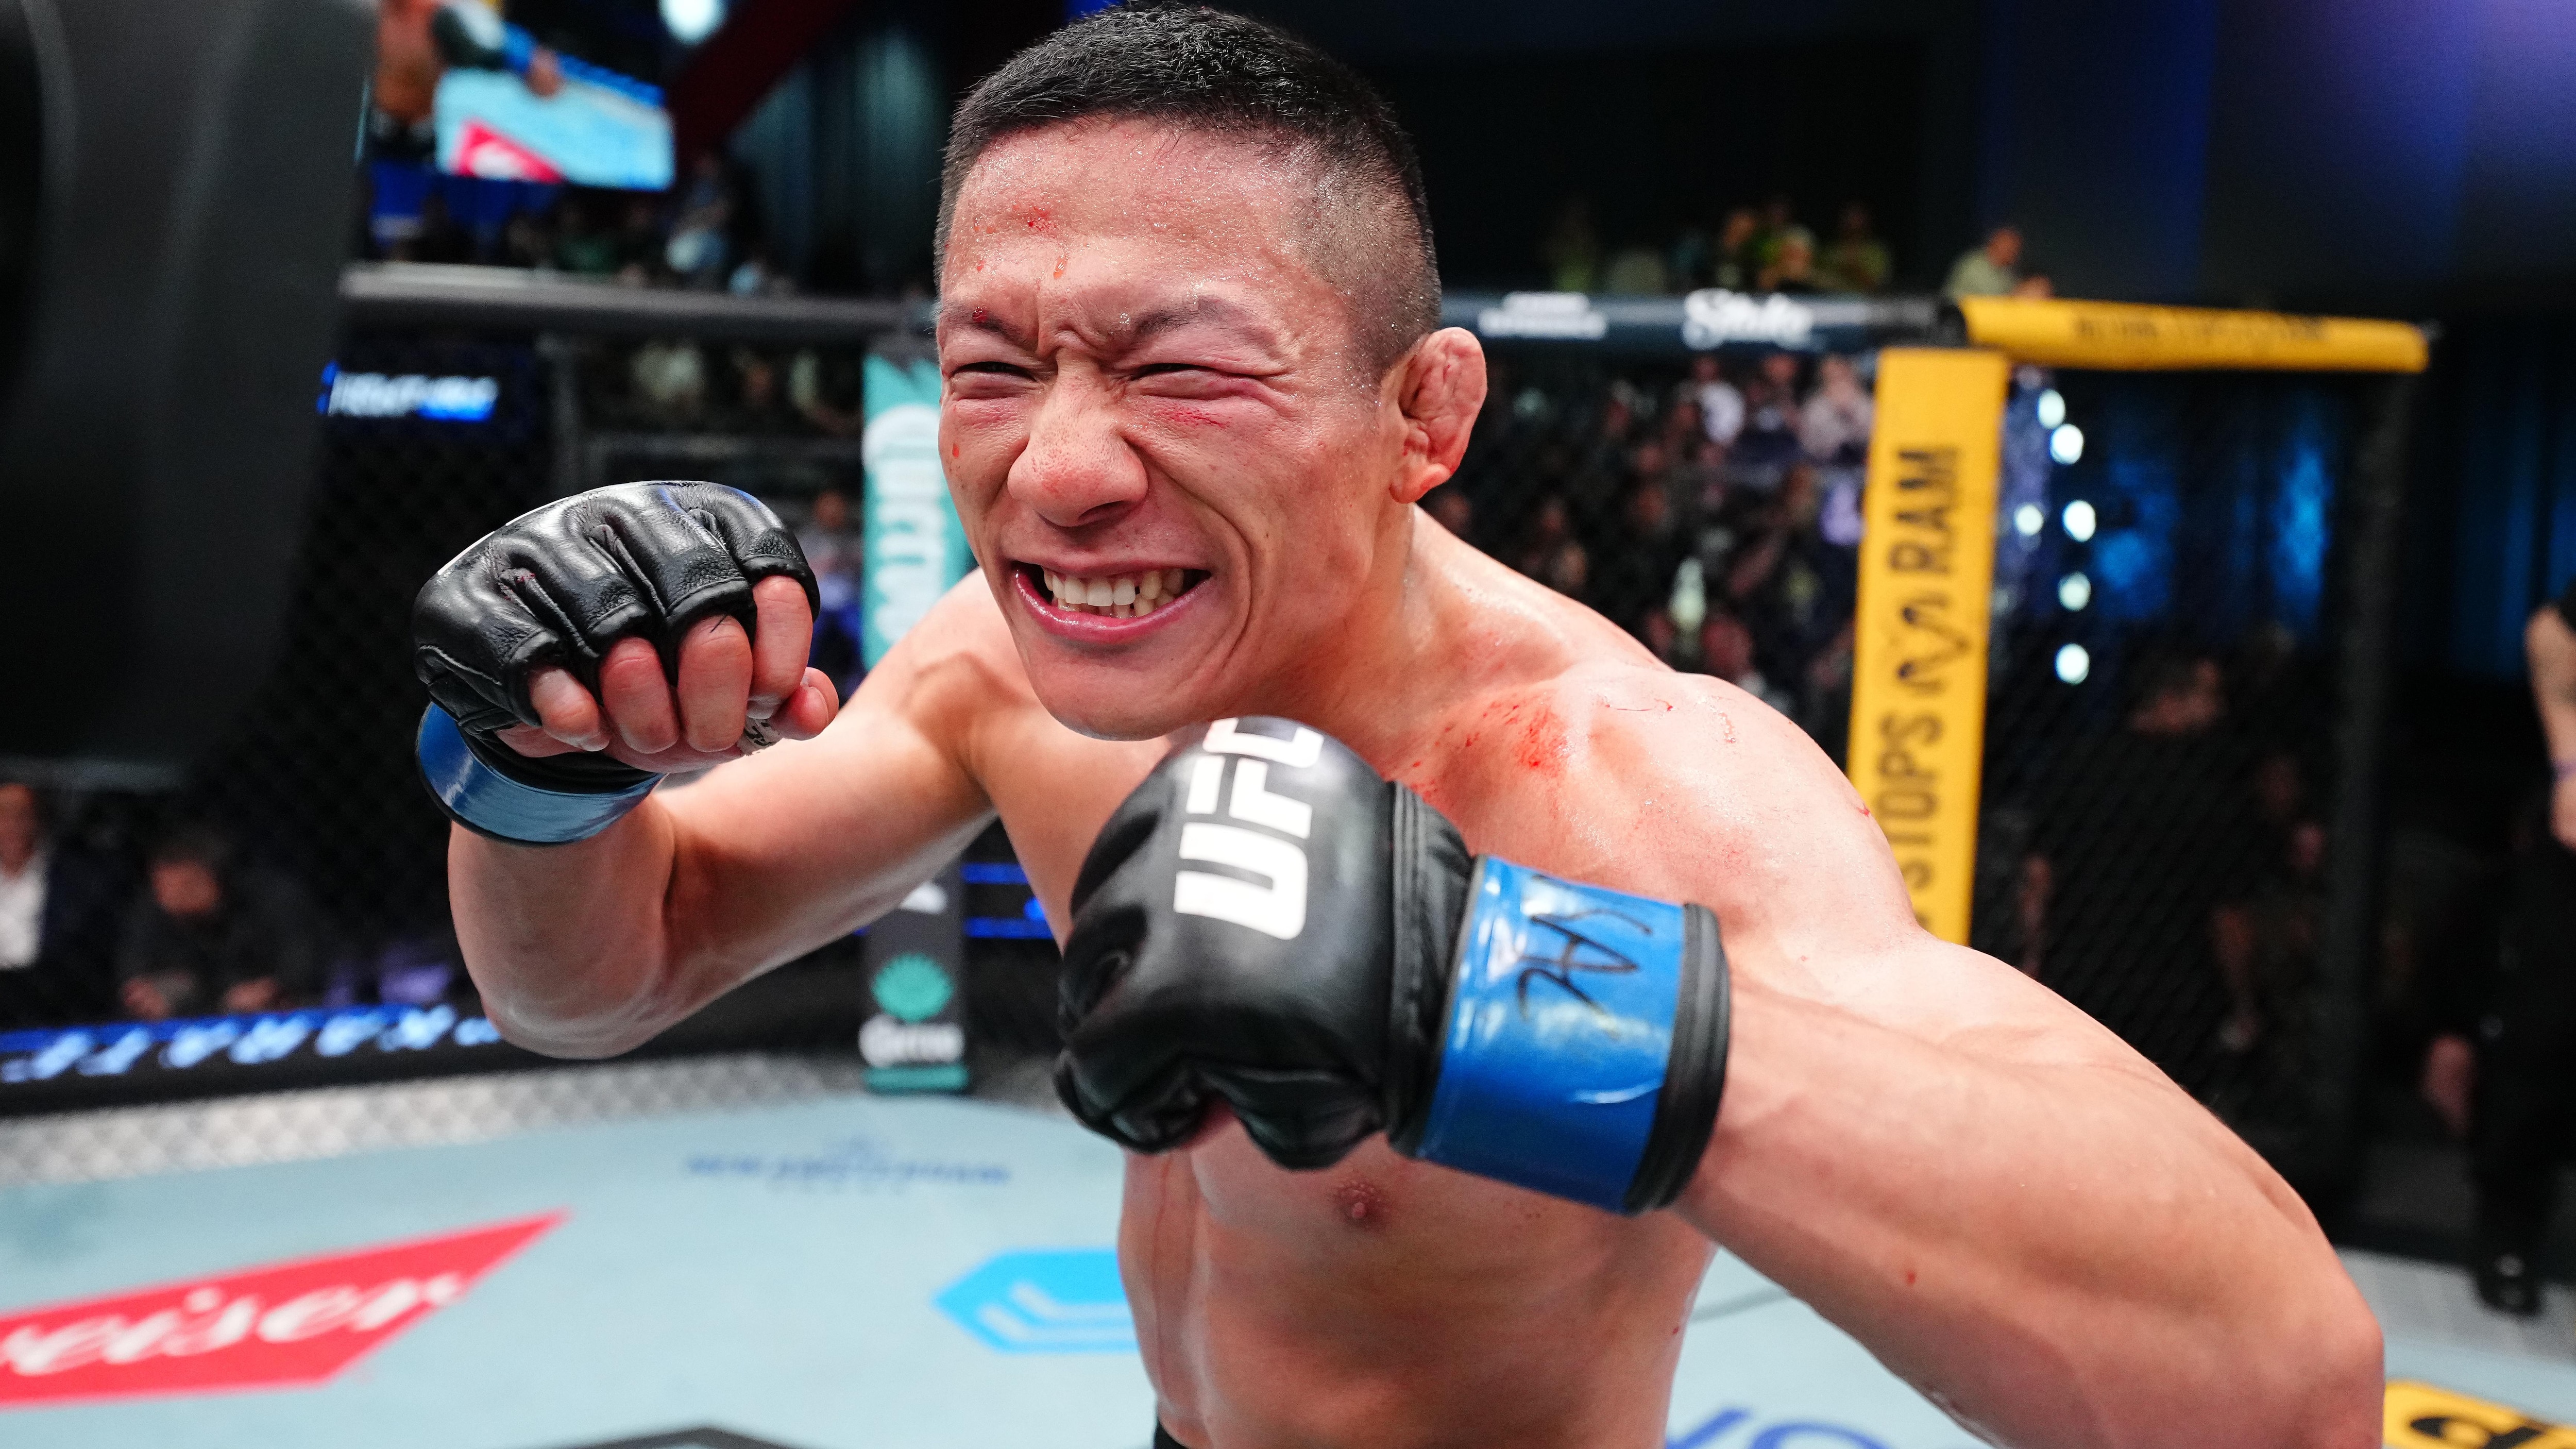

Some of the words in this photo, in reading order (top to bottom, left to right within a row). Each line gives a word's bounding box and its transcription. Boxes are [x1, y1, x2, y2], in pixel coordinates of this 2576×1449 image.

[1888, 446, 1960, 574] RAM
[1173, 717, 1325, 940] UFC
[0, 1270, 466, 1377] eiser
